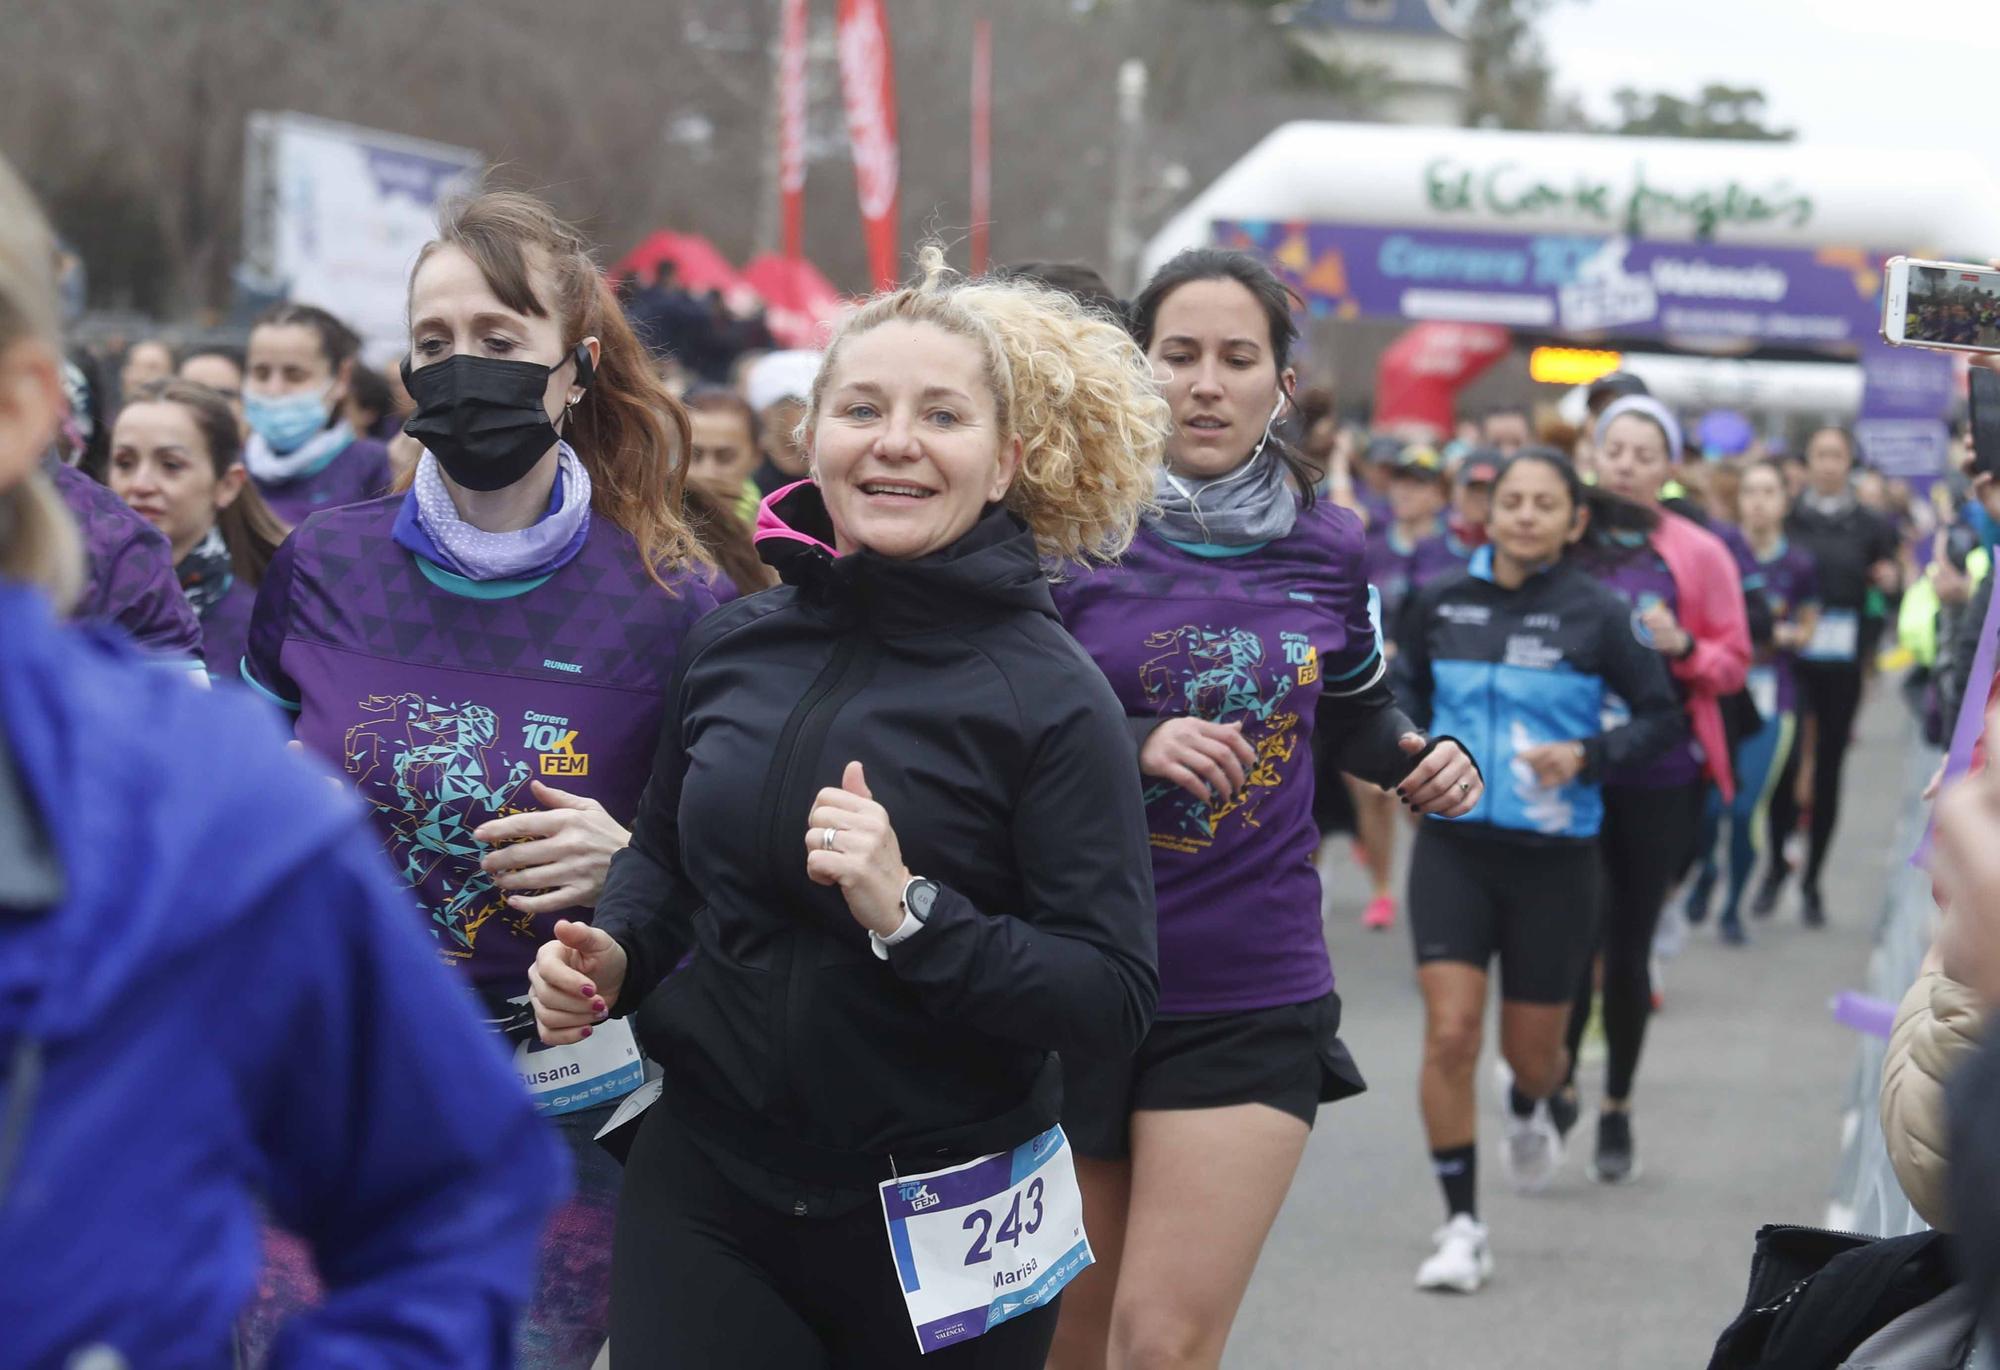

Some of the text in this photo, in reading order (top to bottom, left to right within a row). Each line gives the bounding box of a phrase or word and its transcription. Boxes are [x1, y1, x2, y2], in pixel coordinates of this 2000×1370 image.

[524, 710, 569, 725] Carrera
[522, 723, 579, 756] 10K
[543, 755, 585, 774] FEM
[914, 1194, 938, 1210] FEM
[962, 1176, 1044, 1267] 243
[993, 1257, 1039, 1289] Marisa
